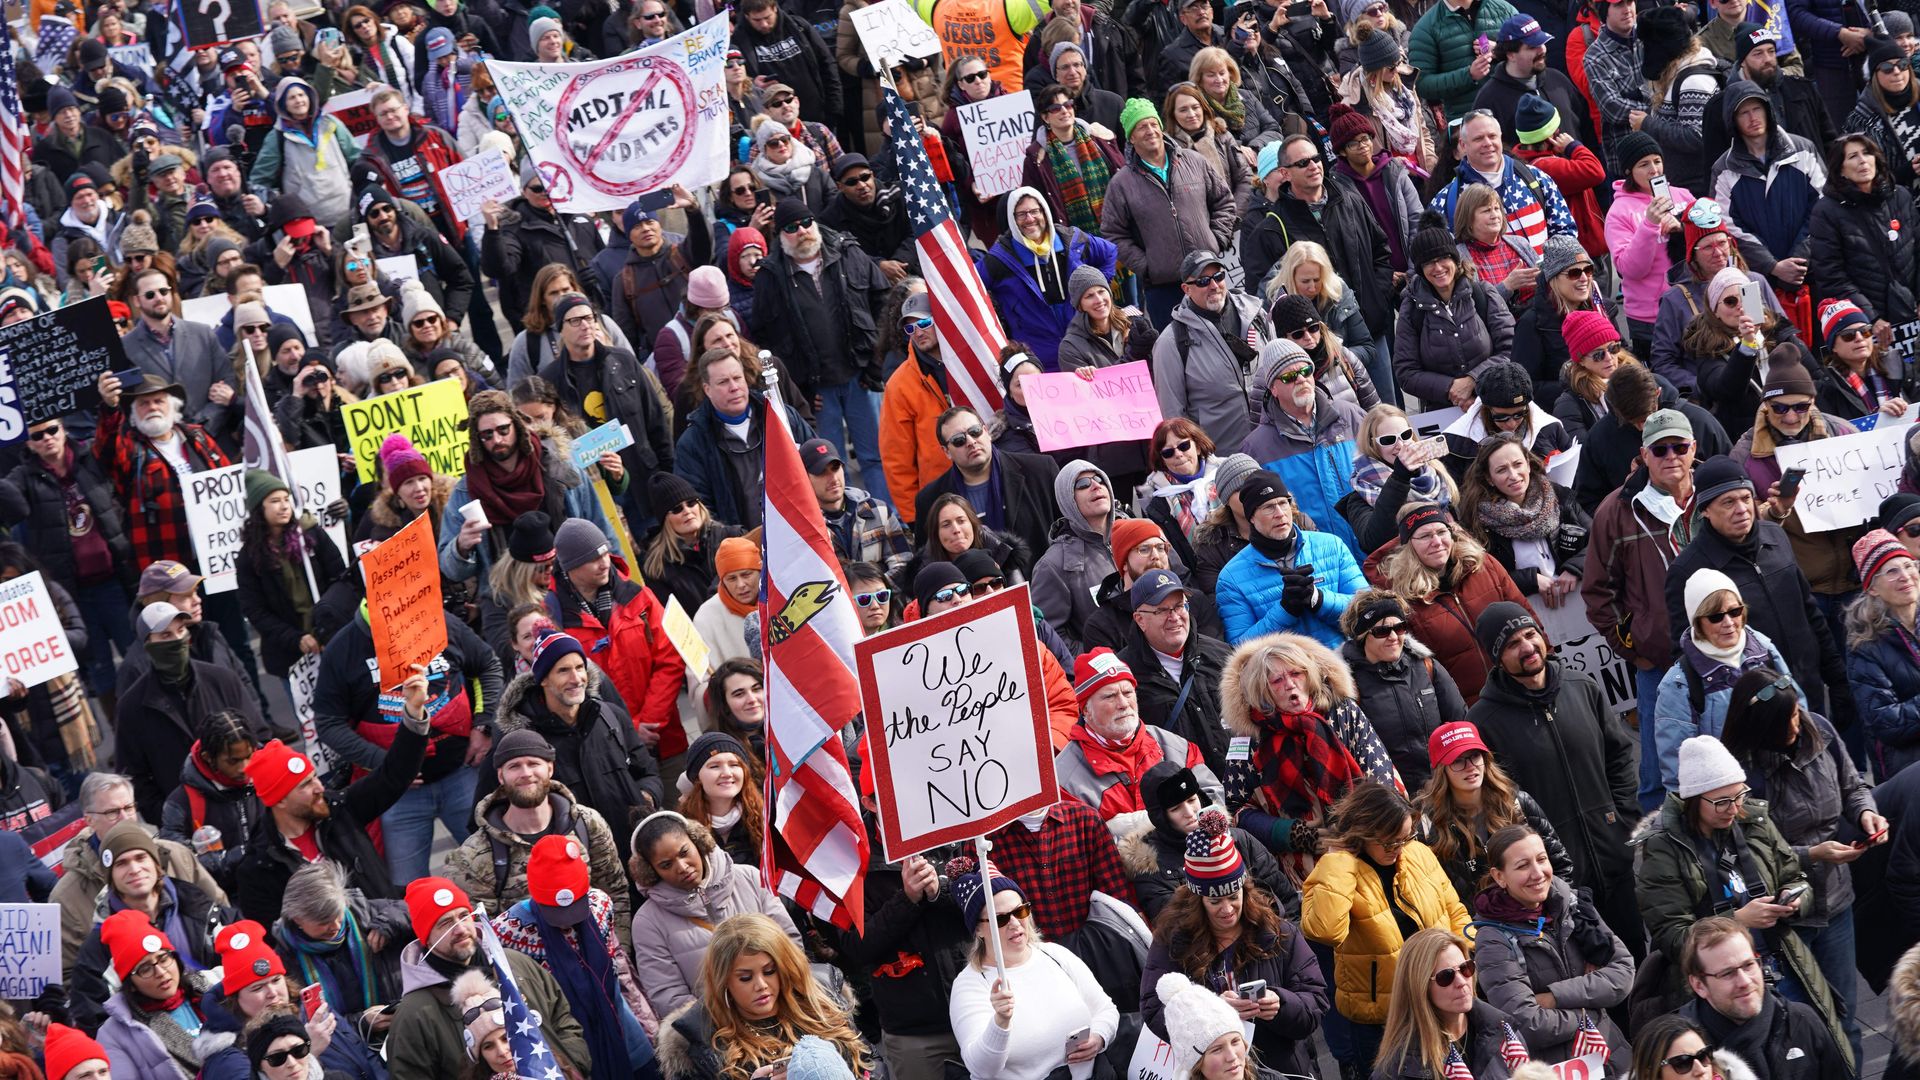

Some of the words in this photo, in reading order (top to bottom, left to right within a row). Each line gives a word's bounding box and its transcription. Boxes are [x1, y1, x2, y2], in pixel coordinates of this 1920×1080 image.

[685, 36, 704, 54] BE
[942, 21, 996, 44] JESUS
[606, 65, 622, 74] NO
[634, 58, 652, 68] TO
[688, 40, 725, 67] BRAVE
[500, 66, 547, 92] EARLY
[698, 83, 725, 109] SPEA
[567, 89, 670, 133] MEDICAL
[959, 104, 989, 125] WE
[977, 111, 1035, 145] STAND
[39, 313, 56, 328] OF
[56, 377, 91, 396] Covid
[1029, 377, 1060, 400] NO
[350, 392, 423, 437] DON'T
[1037, 412, 1069, 439] NO
[411, 413, 460, 449] AWAY
[581, 438, 621, 464] HUMAN
[1804, 487, 1863, 512] PEOPLE
[372, 550, 421, 589] Passports
[401, 571, 422, 588] The
[381, 585, 431, 625] Rubicon
[387, 609, 427, 644] Between
[0, 636, 64, 675] ORCE
[902, 626, 993, 690] We
[885, 706, 940, 748] the
[941, 671, 1026, 731] People
[928, 729, 991, 772] SAY
[927, 758, 1009, 824] NO
[0, 930, 51, 955] AIN!
